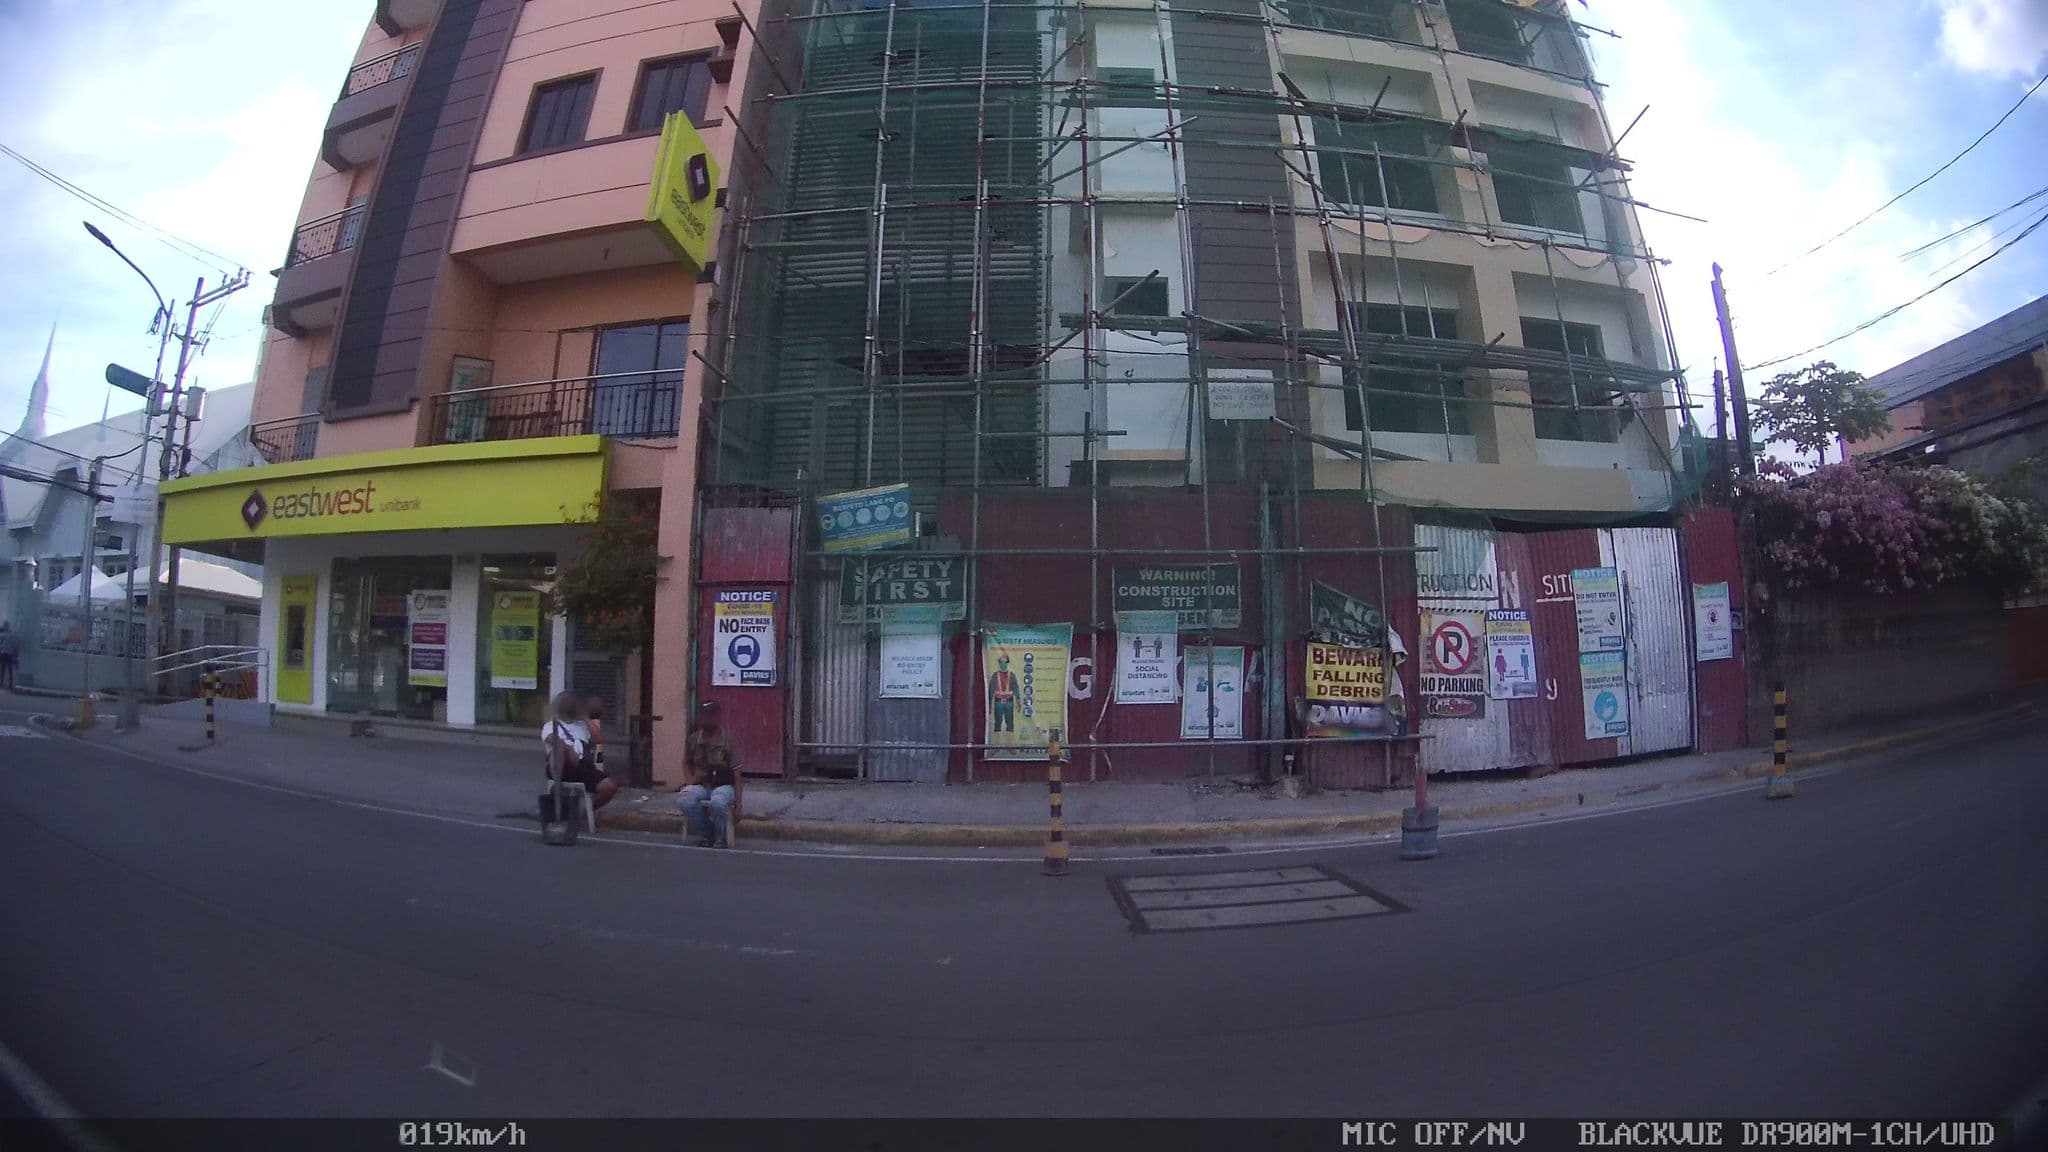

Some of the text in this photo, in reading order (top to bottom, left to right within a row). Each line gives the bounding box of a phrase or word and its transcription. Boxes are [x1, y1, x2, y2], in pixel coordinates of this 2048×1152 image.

[272, 480, 376, 519] eastwest
[380, 496, 422, 512] unibank
[854, 560, 952, 583] SAFETY
[720, 591, 771, 601] NOTICE
[854, 581, 952, 600] FIRST
[1118, 585, 1236, 597] CONSTRUCTION
[1161, 597, 1195, 607] SITE
[1488, 611, 1527, 621] NOTICE
[719, 618, 740, 633] NO
[740, 625, 768, 633] ENTRY
[1312, 670, 1384, 683] FALLING
[1316, 684, 1382, 697] DEBRIS
[1421, 677, 1484, 693] NO PARKING
